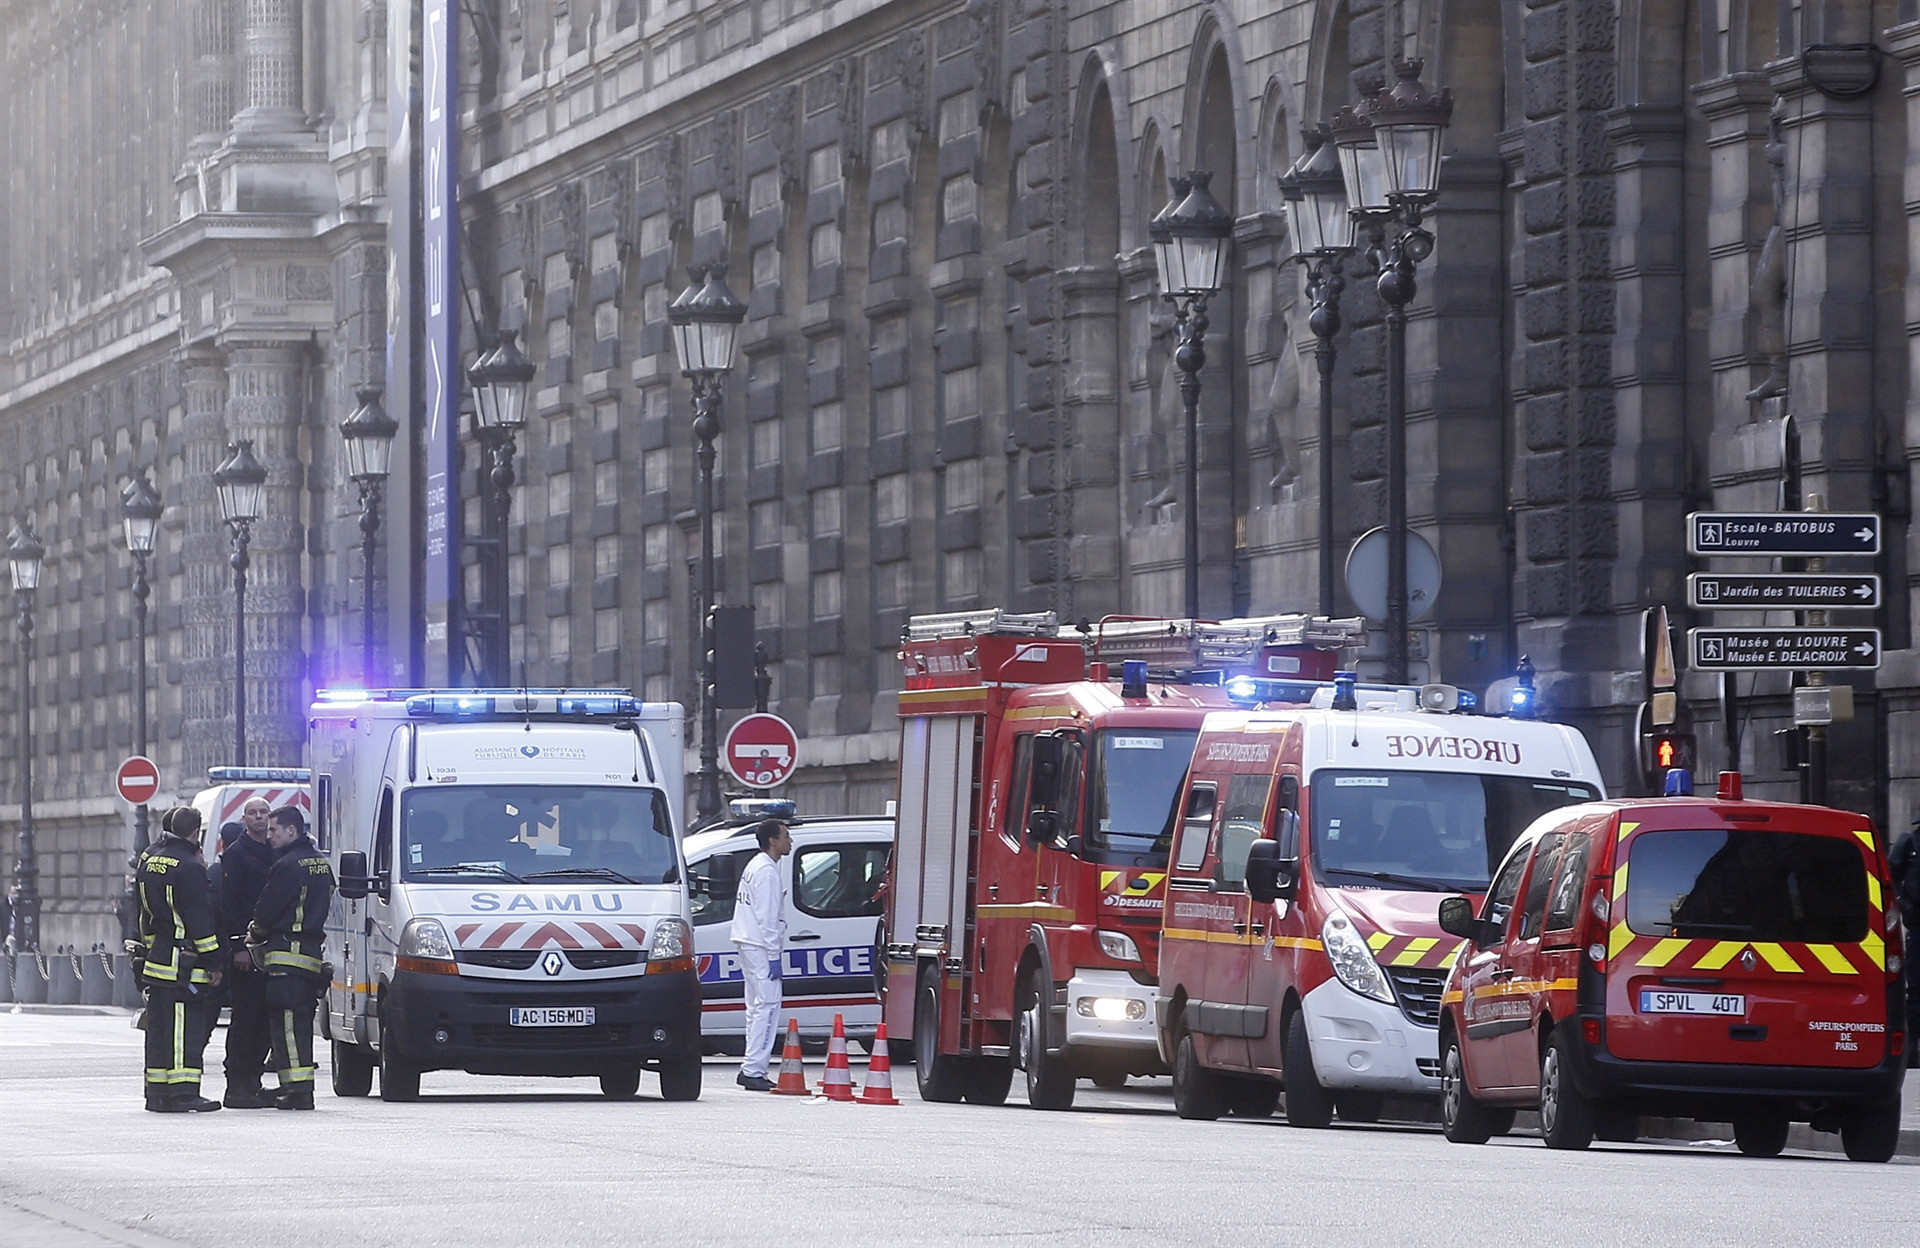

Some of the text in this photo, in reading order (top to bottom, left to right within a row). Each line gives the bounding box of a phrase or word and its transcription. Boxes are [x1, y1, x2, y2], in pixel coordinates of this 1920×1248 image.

[1725, 522, 1836, 533] Escale-BATOBUS
[1725, 537, 1760, 547] Louvre
[1723, 585, 1847, 597] Jardin des TUILERIES
[1728, 637, 1848, 648] Musée du LOUVRE
[1728, 651, 1848, 662] Musée E. DELACROIX
[146, 863, 168, 874] PARIS
[308, 864, 329, 875] PARIS
[470, 892, 623, 912] SAMU
[719, 948, 871, 979] PLICE
[1656, 994, 1739, 1012] SPVL 407
[1808, 1021, 1885, 1033] SAPEURS-POMPIERS
[1840, 1032, 1852, 1041] DE
[1835, 1042, 1858, 1051] PARIS
